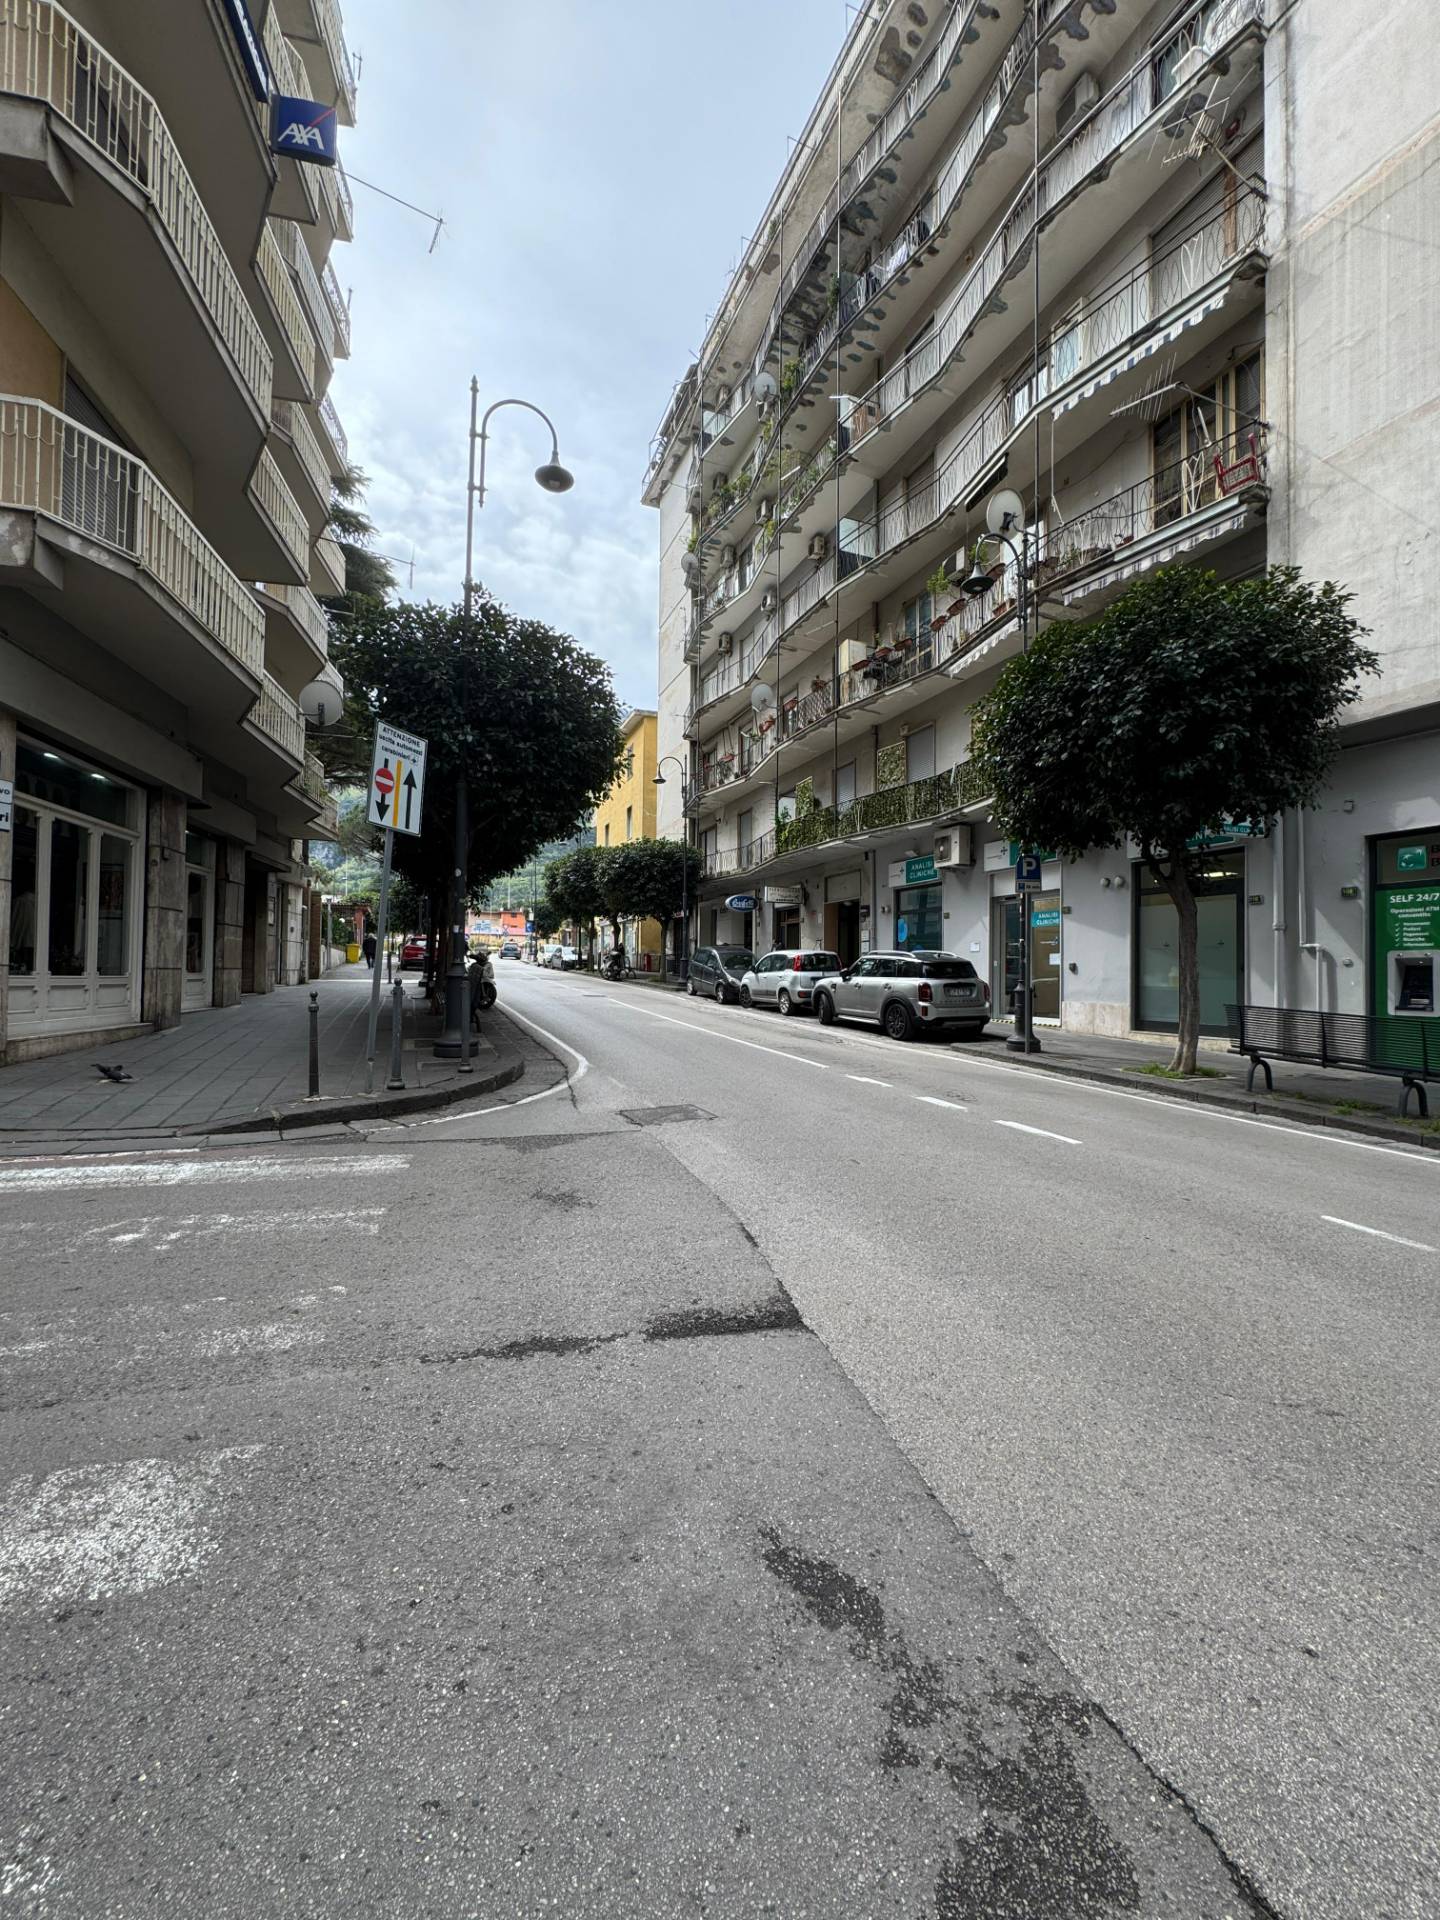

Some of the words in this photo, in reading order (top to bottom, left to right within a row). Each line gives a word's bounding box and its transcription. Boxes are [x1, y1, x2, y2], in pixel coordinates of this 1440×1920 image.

[278, 122, 324, 150] AXA
[383, 727, 420, 747] ATTENZIONE
[1022, 858, 1037, 877] P
[1390, 894, 1414, 903] SELF
[1416, 893, 1440, 902] 24/7
